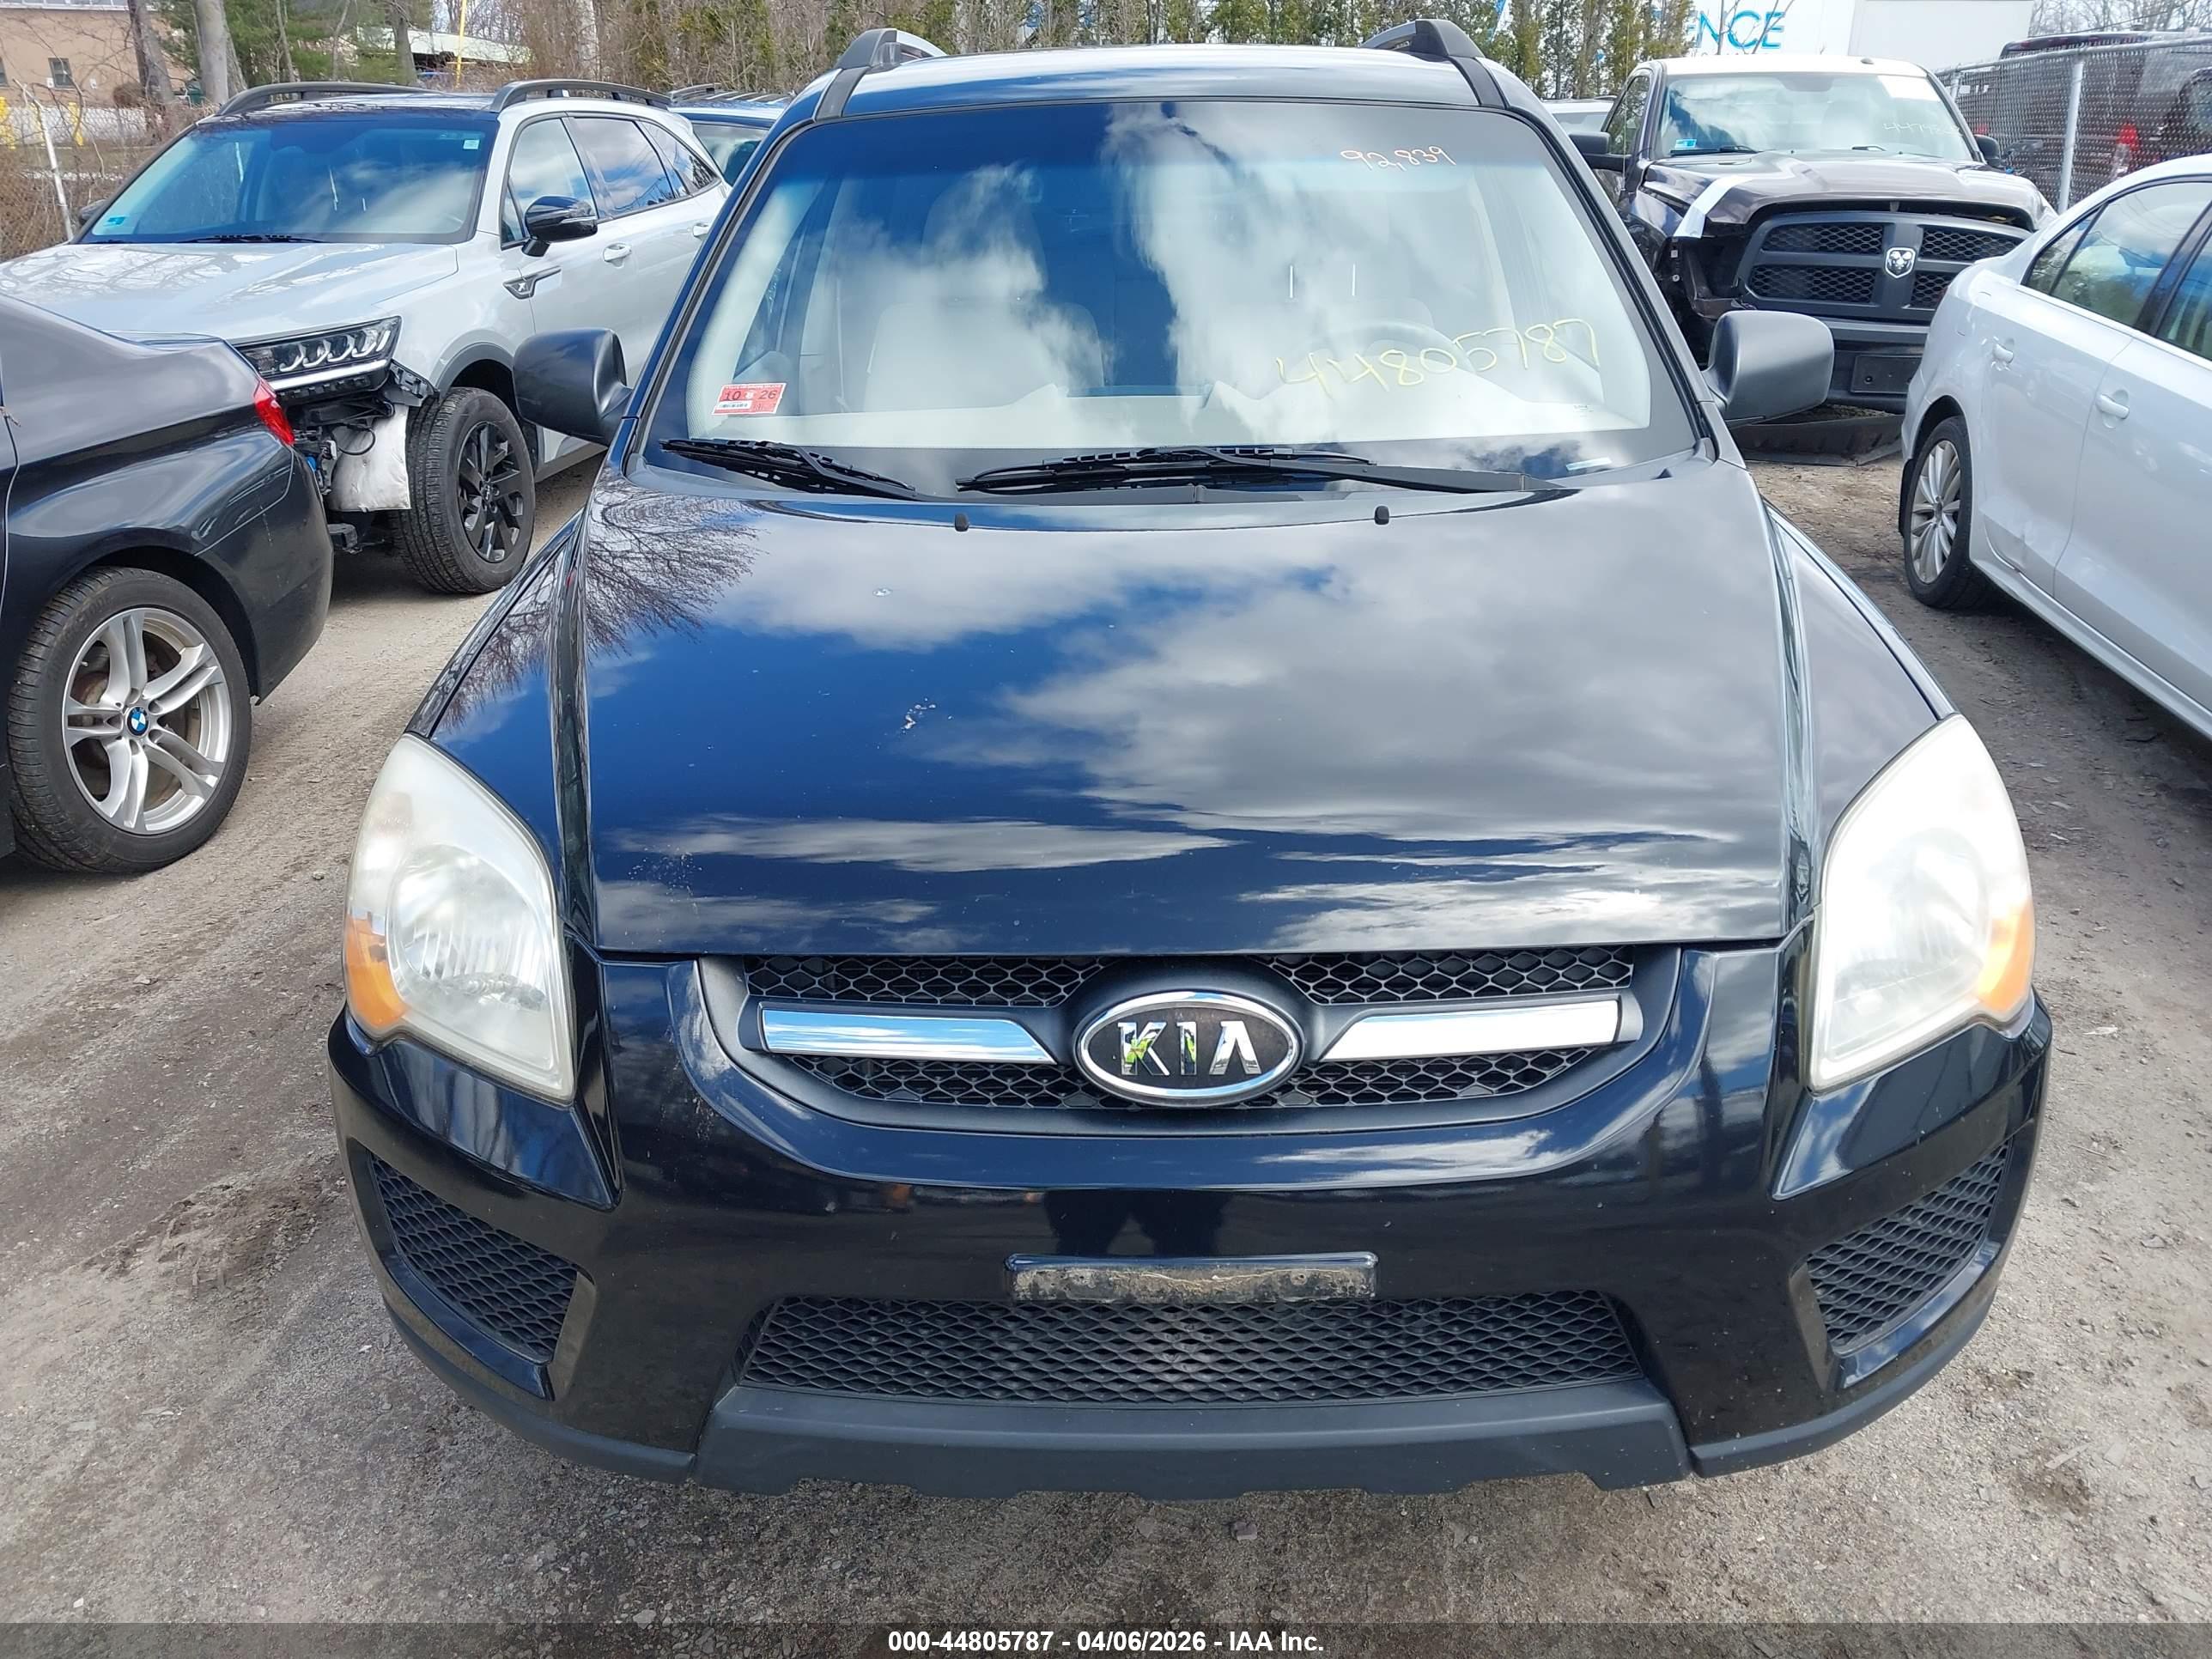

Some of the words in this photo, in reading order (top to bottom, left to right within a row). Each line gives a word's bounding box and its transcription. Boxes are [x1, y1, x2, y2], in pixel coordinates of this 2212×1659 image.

[1340, 145, 1457, 172] 92,839
[1275, 318, 1601, 401] 44805787
[723, 391, 741, 402] 10
[757, 390, 778, 400] 26
[1117, 1020, 1263, 1076] KIA
